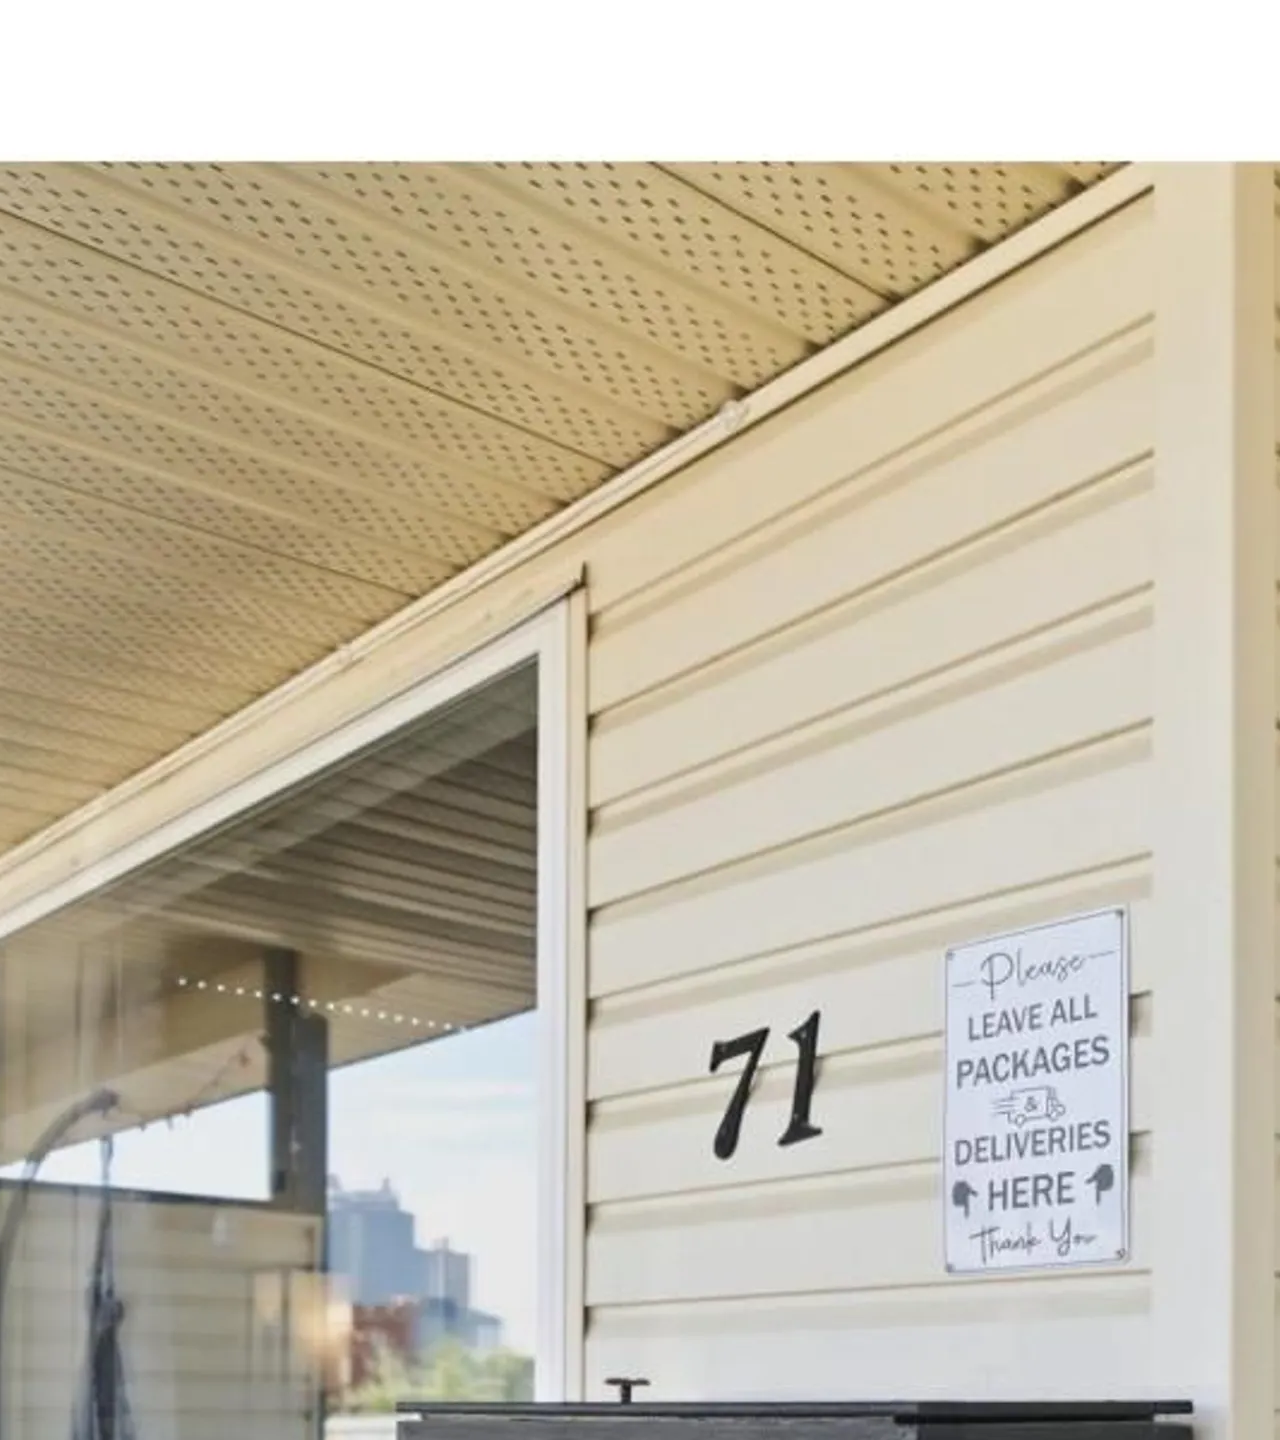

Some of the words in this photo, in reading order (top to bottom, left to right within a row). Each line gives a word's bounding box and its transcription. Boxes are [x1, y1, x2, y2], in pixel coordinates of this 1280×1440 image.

[980, 947, 1086, 1001] Please
[967, 1001, 1043, 1041] LEAVE
[1050, 993, 1099, 1022] ALL
[708, 1008, 824, 1161] 71
[955, 1035, 1111, 1090] PACKAGES
[1024, 1095, 1039, 1114] &
[953, 1119, 1112, 1167] DELIVERIES
[987, 1170, 1076, 1212] HERE
[969, 1219, 1042, 1265] Thank
[1049, 1216, 1099, 1257] You
